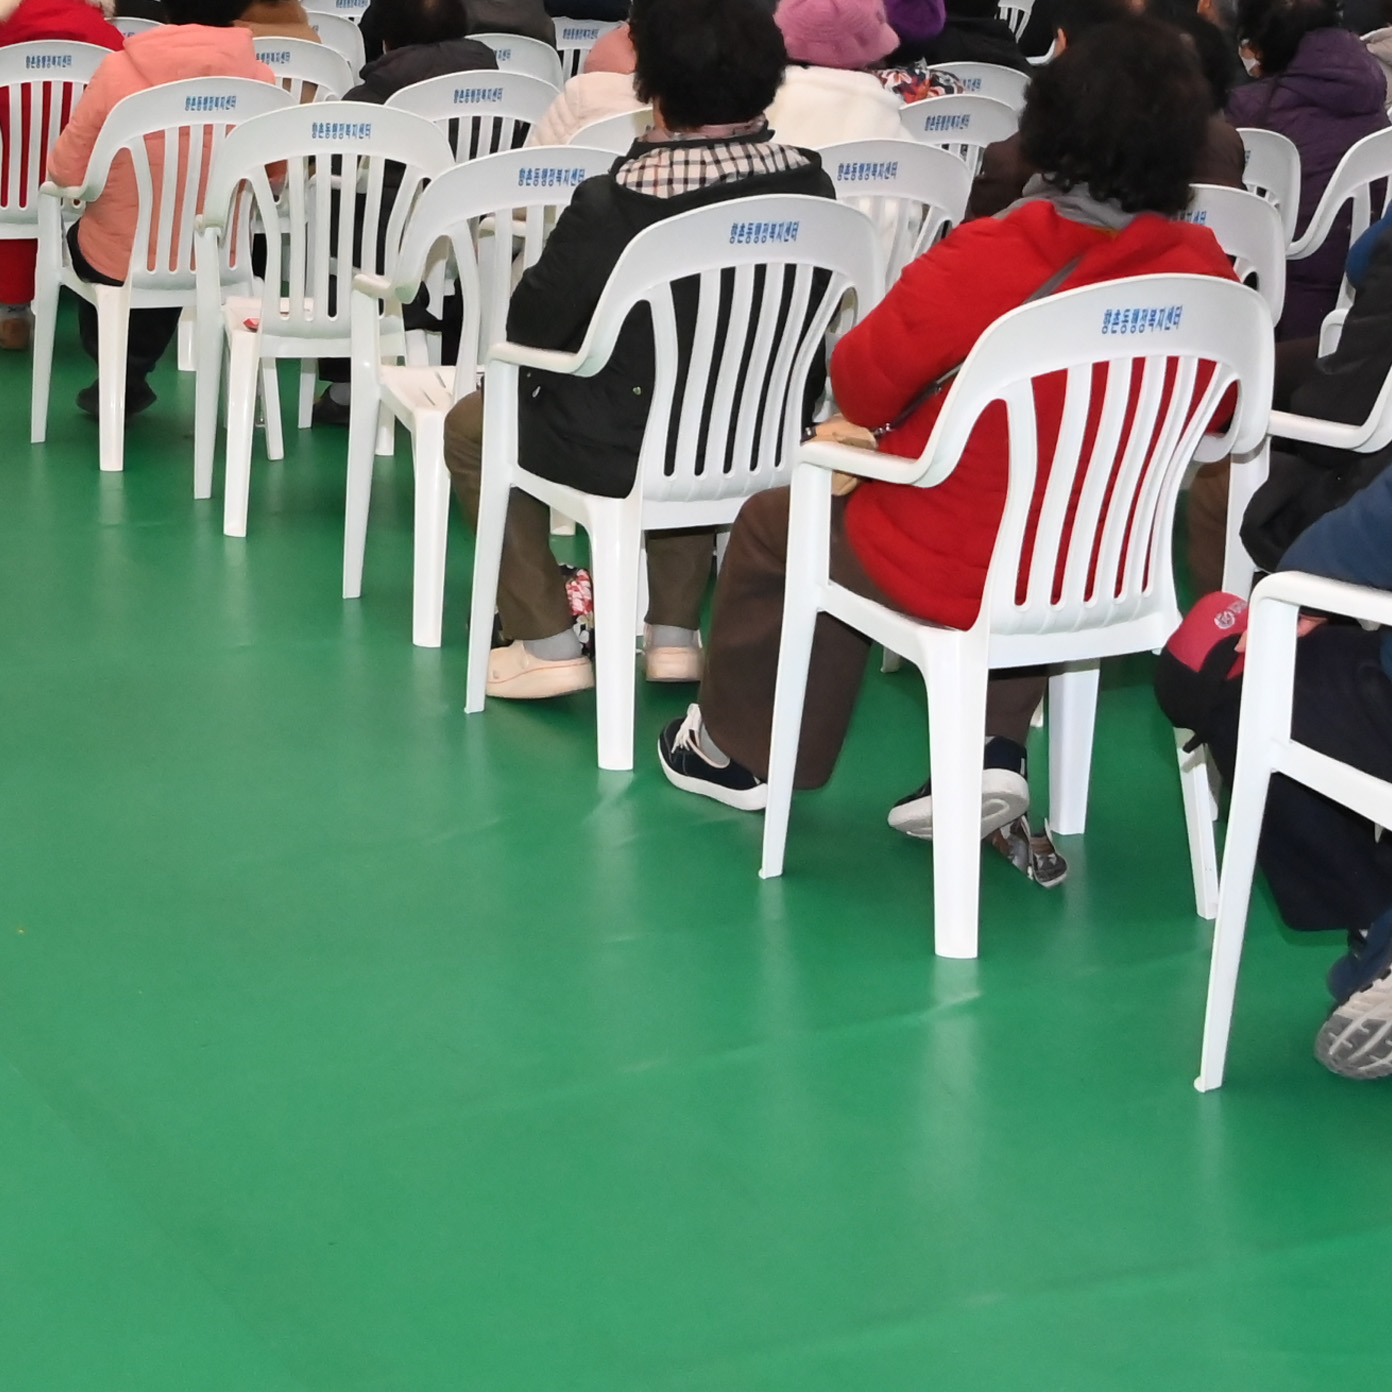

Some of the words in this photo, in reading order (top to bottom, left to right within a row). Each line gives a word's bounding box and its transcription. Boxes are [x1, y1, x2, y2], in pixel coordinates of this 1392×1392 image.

[185, 96, 237, 111] 향촌동행정복지센터
[454, 88, 503, 104] 향촌동행정복지센터
[311, 122, 371, 139] 향촌동행정복지센터
[837, 161, 898, 181] 향촌동행정복지센터
[729, 221, 799, 244] 향촌동행정복지센터
[1101, 305, 1183, 335] 향촌동행정복지센터
